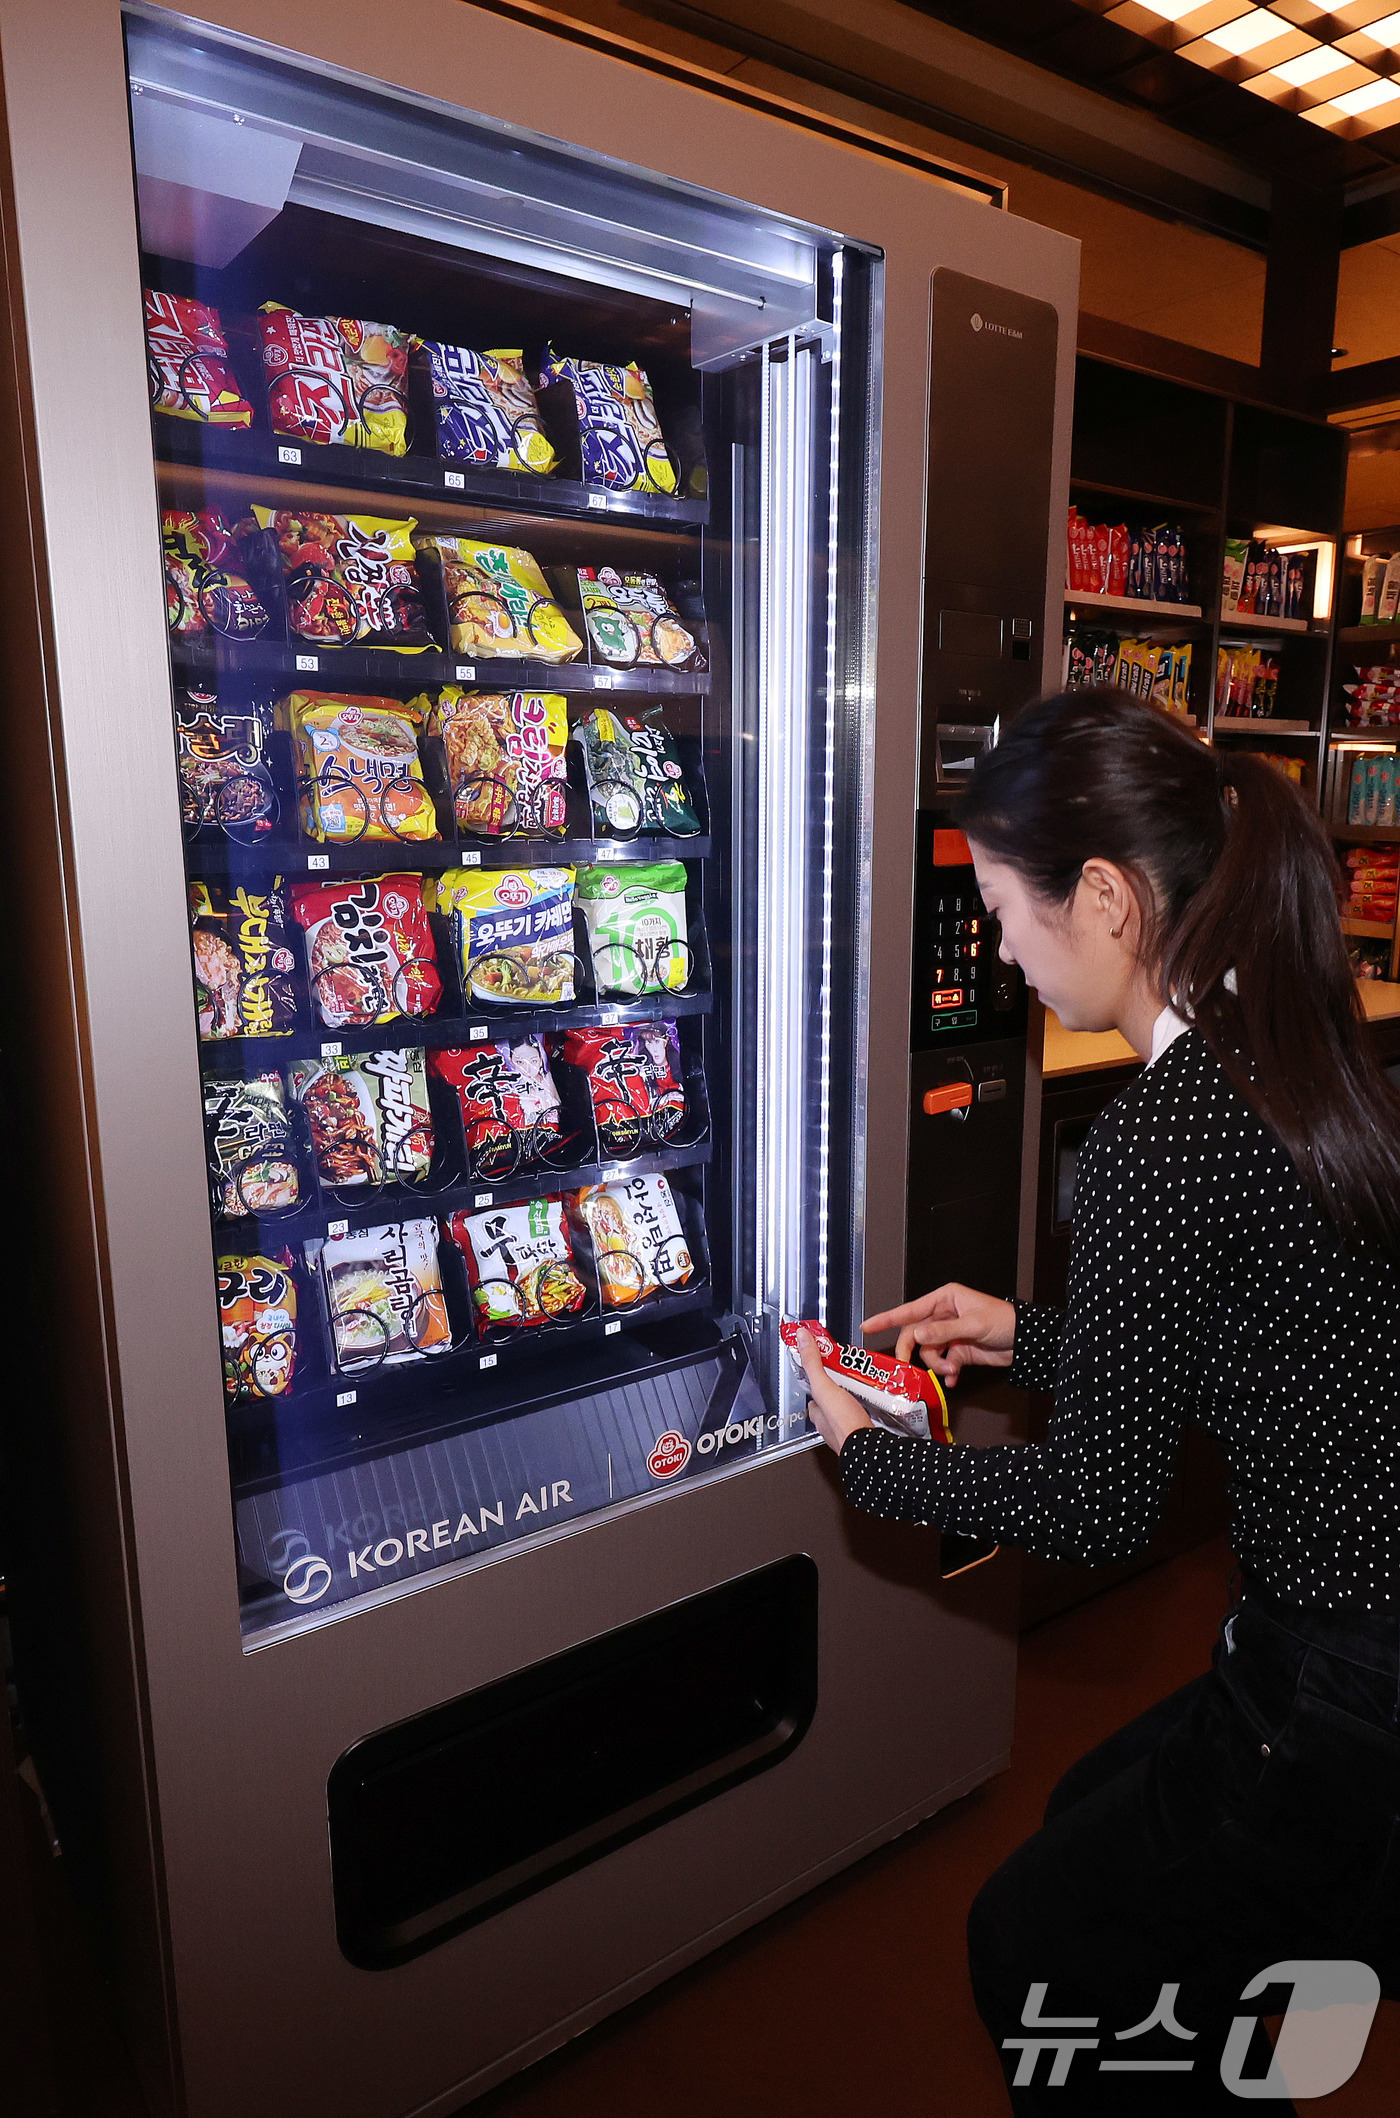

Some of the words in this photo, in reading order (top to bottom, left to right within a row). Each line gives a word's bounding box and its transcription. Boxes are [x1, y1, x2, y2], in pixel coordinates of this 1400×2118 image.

[288, 317, 358, 421] 진라면
[283, 450, 298, 462] 63
[448, 475, 462, 486] 65
[592, 496, 604, 506] 67
[335, 520, 395, 632] 진짬뽕
[300, 658, 315, 669] 53
[459, 668, 473, 679] 55
[597, 677, 609, 687] 57
[507, 692, 551, 829] 크림진짬뽕
[317, 754, 413, 797] 스낵면
[465, 853, 478, 864] 45
[600, 849, 612, 859] 47
[311, 857, 326, 868] 43
[500, 891, 529, 905] 오뚜기
[938, 899, 944, 912] A
[956, 898, 962, 911] B
[475, 914, 532, 948] 오뚜기
[534, 900, 574, 933] 카레면
[955, 921, 961, 935] 2
[971, 919, 978, 934] 3
[634, 936, 671, 960] 채황
[936, 946, 943, 960] 4
[954, 944, 960, 958] 5
[970, 942, 977, 957] 6
[936, 969, 943, 983] 7
[953, 968, 959, 982] 8
[970, 966, 976, 979] 9
[969, 989, 975, 1003] 0
[604, 1013, 616, 1024] 37
[472, 1028, 486, 1039] 35
[324, 1043, 339, 1055] 33
[595, 1037, 648, 1105] 辛
[643, 1063, 668, 1079] 라면
[362, 1049, 416, 1172] 짜파게티
[243, 1120, 287, 1142] 라면
[604, 1170, 616, 1180] 27
[477, 1195, 491, 1205] 25
[331, 1222, 345, 1233] 23
[623, 1177, 675, 1275] 안성탕면
[607, 1323, 620, 1332] 17
[482, 1357, 495, 1367] 15
[840, 1343, 890, 1383] 김치라면
[340, 1393, 353, 1405] 13
[696, 1414, 764, 1454] OTOKI
[653, 1451, 683, 1470] OTOKI
[348, 1501, 504, 1579] KOREAN
[515, 1480, 574, 1521] AIR
